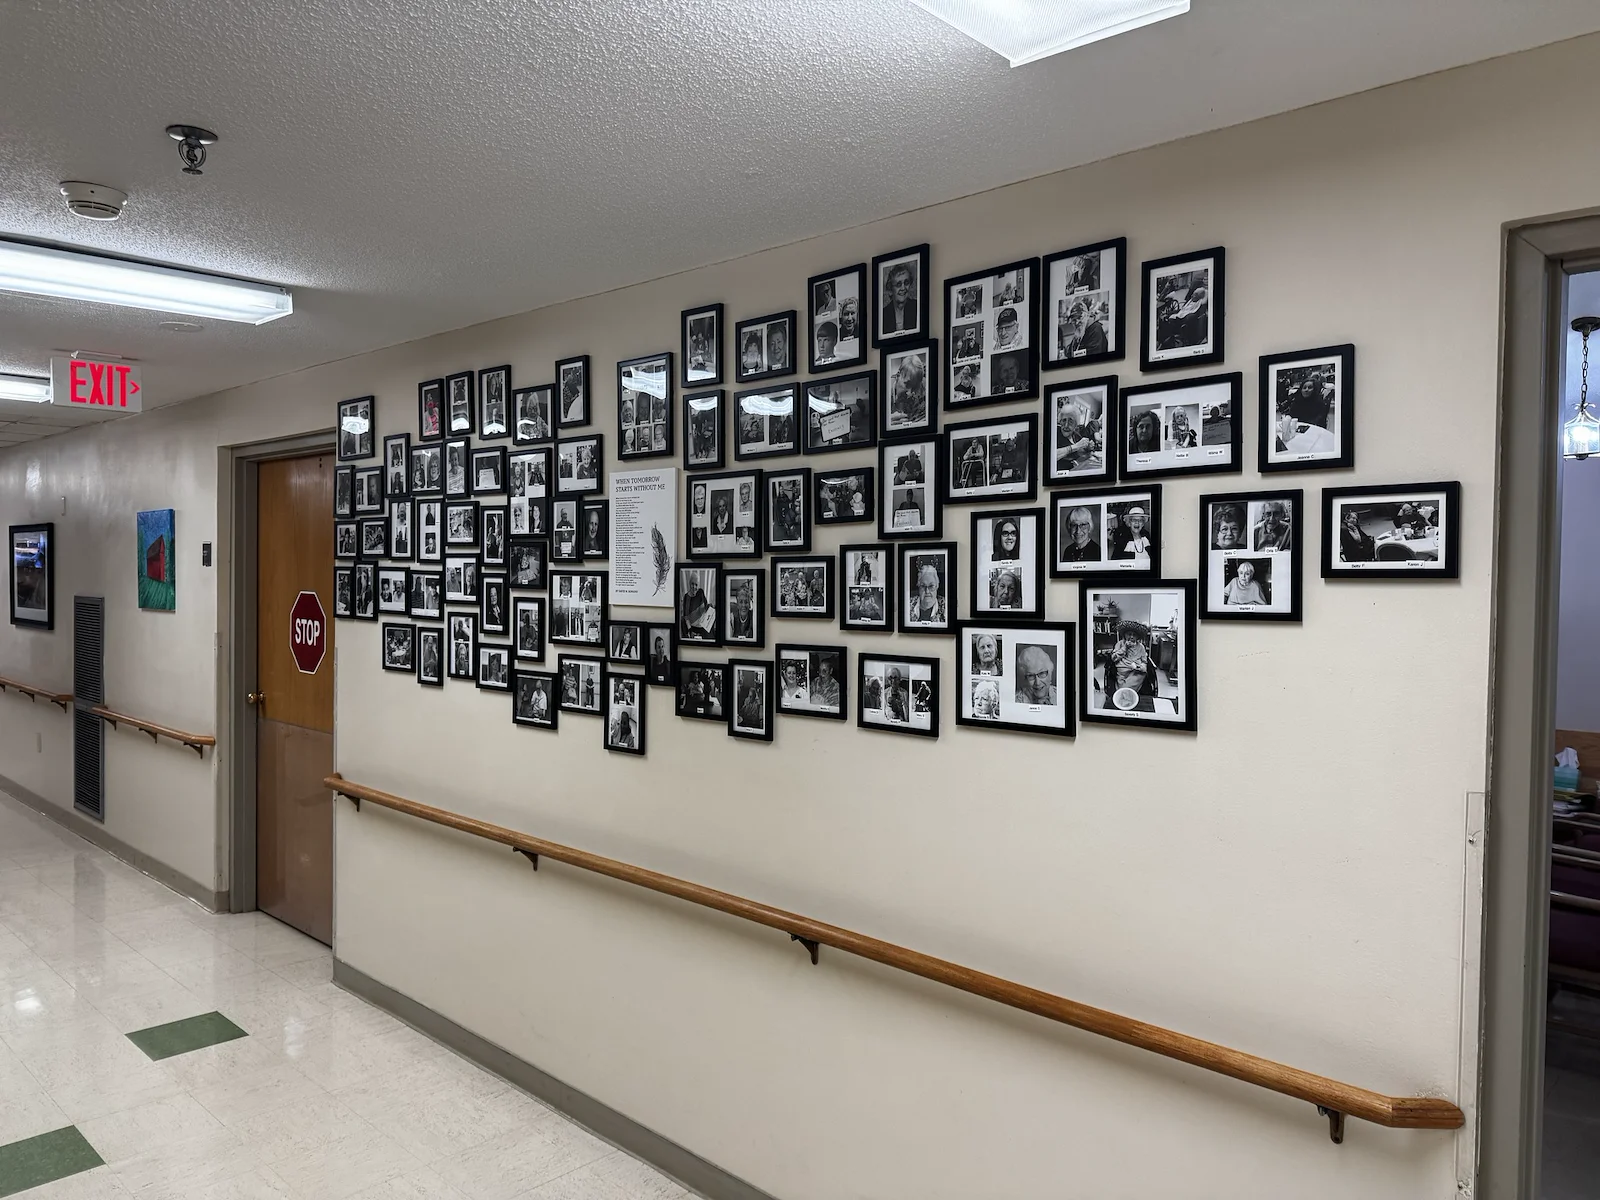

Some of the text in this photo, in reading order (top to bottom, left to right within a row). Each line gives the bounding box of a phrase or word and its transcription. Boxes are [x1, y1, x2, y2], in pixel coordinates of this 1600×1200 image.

[70, 361, 131, 407] EXIT
[631, 476, 660, 484] TOMORROW
[295, 618, 320, 646] STOP
